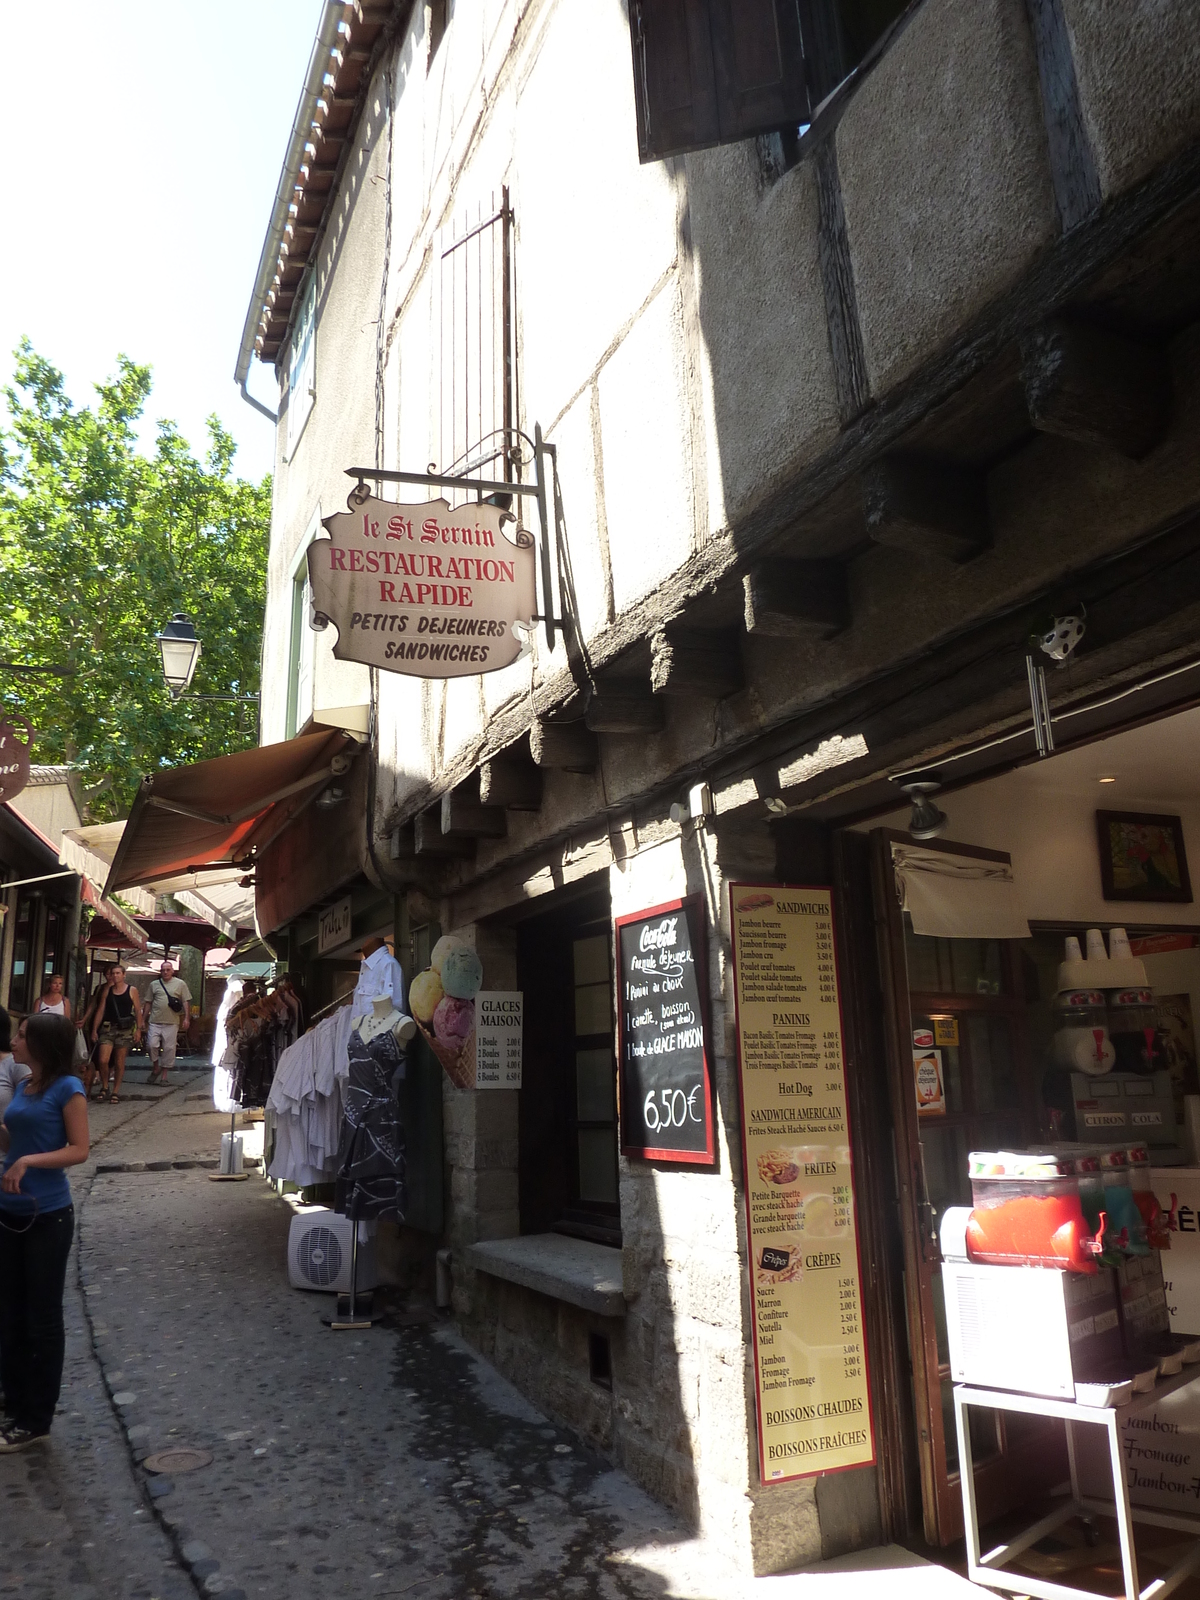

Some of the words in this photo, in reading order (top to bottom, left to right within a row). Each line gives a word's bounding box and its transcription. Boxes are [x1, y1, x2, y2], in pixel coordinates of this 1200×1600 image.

[363, 513, 380, 539] le
[386, 516, 413, 540] St
[419, 518, 495, 548] Sernin
[329, 548, 515, 582] RESTAURATION
[379, 581, 473, 607] RAPIDE
[350, 613, 408, 631] PETITS
[418, 616, 507, 636] DEJEUNERS
[385, 642, 489, 662] SANDWICHES
[777, 902, 829, 914] SANDWICHS
[653, 983, 660, 993] au
[662, 976, 683, 993] choix
[482, 1001, 521, 1012] GLACES
[661, 1001, 690, 1018] boisson
[481, 1015, 521, 1026] MAISON
[772, 1014, 810, 1025] PANINIS
[482, 1038, 497, 1046] Boule
[654, 1034, 676, 1054] GLACE
[677, 1026, 703, 1049] MAISON
[482, 1049, 499, 1057] Boules
[482, 1060, 499, 1069] Boules
[482, 1072, 499, 1081] Boules
[778, 1083, 794, 1094] Hot
[796, 1082, 812, 1097] Dog
[751, 1108, 795, 1121] SANDWICH
[797, 1107, 841, 1119] AMERICAIN
[1086, 1116, 1124, 1124] CITRON
[1133, 1115, 1161, 1123] COLA
[749, 1127, 766, 1135] Frites
[767, 1125, 786, 1134] Steack
[788, 1124, 806, 1133] Haché
[807, 1124, 826, 1132] Sauces
[805, 1162, 836, 1174] FRITES
[752, 1192, 770, 1200] Petite
[771, 1190, 800, 1201] Barquette
[752, 1203, 766, 1211] avec
[767, 1202, 785, 1210] steack
[753, 1213, 775, 1223] Grande
[777, 1211, 805, 1222] barquette
[753, 1226, 766, 1234] avec
[767, 1224, 786, 1233] steack
[787, 1222, 804, 1230] haché
[806, 1252, 841, 1268] CRÊPES
[757, 1287, 775, 1296] Sucre
[757, 1300, 781, 1308] Marron
[758, 1310, 788, 1320] Confiture
[759, 1322, 782, 1333] Nutella
[759, 1335, 774, 1345] Miel
[761, 1354, 785, 1368] Jambon
[762, 1368, 790, 1378] Fromage
[762, 1380, 787, 1393] Jambon
[788, 1376, 815, 1387] Fromage
[766, 1405, 815, 1425] BOISSONS
[817, 1398, 863, 1417] CHAUDES
[1121, 1414, 1179, 1434] Jambon
[769, 1438, 818, 1459] BOISSONS
[820, 1429, 867, 1449] FRAÎCHES
[1123, 1438, 1190, 1467] Fromage
